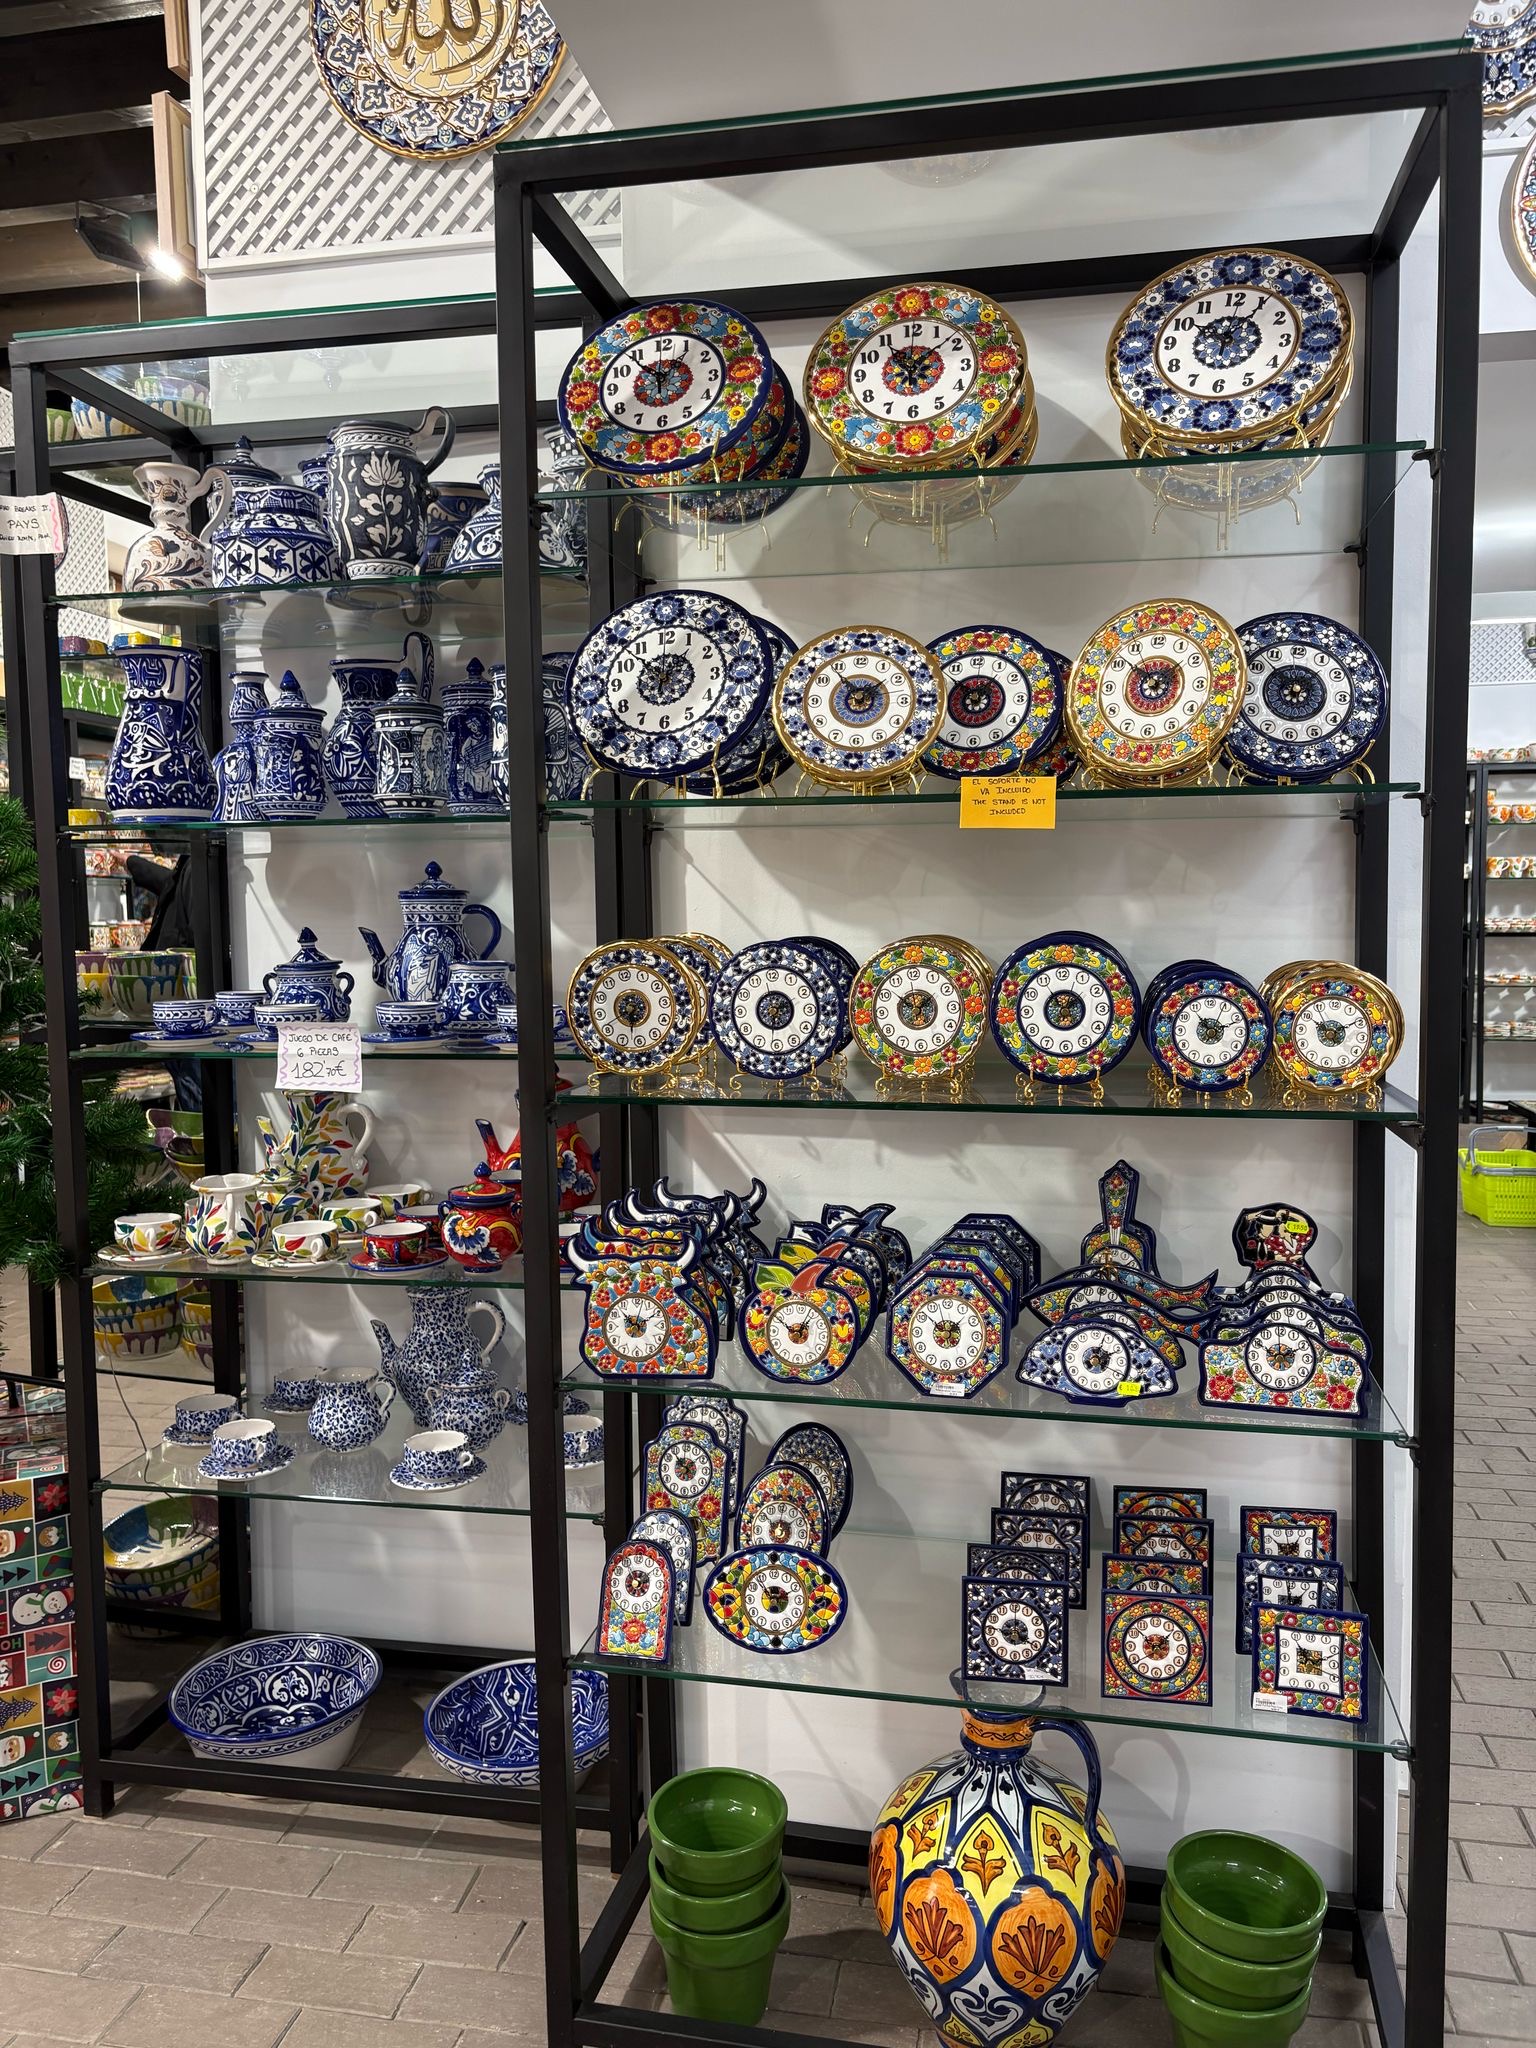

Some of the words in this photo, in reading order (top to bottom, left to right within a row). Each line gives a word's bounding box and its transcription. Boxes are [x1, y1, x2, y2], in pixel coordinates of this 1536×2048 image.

[1225, 292, 1246, 307] 12
[1197, 301, 1211, 314] 11
[1174, 317, 1194, 331] 10
[1273, 311, 1286, 325] 2
[903, 324, 922, 337] 12
[934, 326, 940, 338] 1
[655, 339, 672, 352] 12
[684, 340, 689, 352] 1
[879, 334, 892, 347] 11
[952, 338, 963, 351] 2
[1164, 336, 1176, 350] 9
[1279, 334, 1291, 347] 3
[632, 349, 643, 361] 11
[700, 351, 711, 363] 2
[861, 350, 879, 364] 10
[1266, 355, 1279, 368] 4
[961, 358, 971, 371] 3
[1168, 359, 1180, 372] 8
[613, 365, 631, 378] 10
[709, 369, 718, 381] 3
[854, 369, 866, 382] 9
[953, 379, 965, 391] 4
[1188, 374, 1200, 387] 7
[1242, 372, 1255, 386] 5
[607, 383, 618, 396] 9
[1212, 379, 1225, 393] 6
[701, 388, 712, 400] 4
[863, 390, 874, 403] 8
[614, 402, 625, 414] 8
[884, 402, 894, 414] 7
[935, 396, 944, 410] 5
[683, 406, 692, 418] 5
[908, 405, 918, 418] 6
[634, 413, 644, 425] 7
[657, 415, 667, 427] 6
[7, 518, 39, 529] PAYS
[658, 631, 675, 645] 12
[686, 633, 691, 646] 1
[636, 642, 647, 655] 11
[703, 646, 713, 659] 2
[617, 659, 634, 673] 10
[710, 667, 720, 680] 3
[611, 679, 622, 692] 9
[703, 688, 712, 701] 4
[618, 699, 629, 713] 8
[637, 712, 646, 725] 7
[685, 707, 694, 720] 5
[659, 715, 670, 729] 6
[289, 1034, 312, 1042] JUEGO
[332, 1033, 352, 1041] CAFE
[297, 1048, 304, 1057] 6
[309, 1047, 339, 1056] PIEZAS
